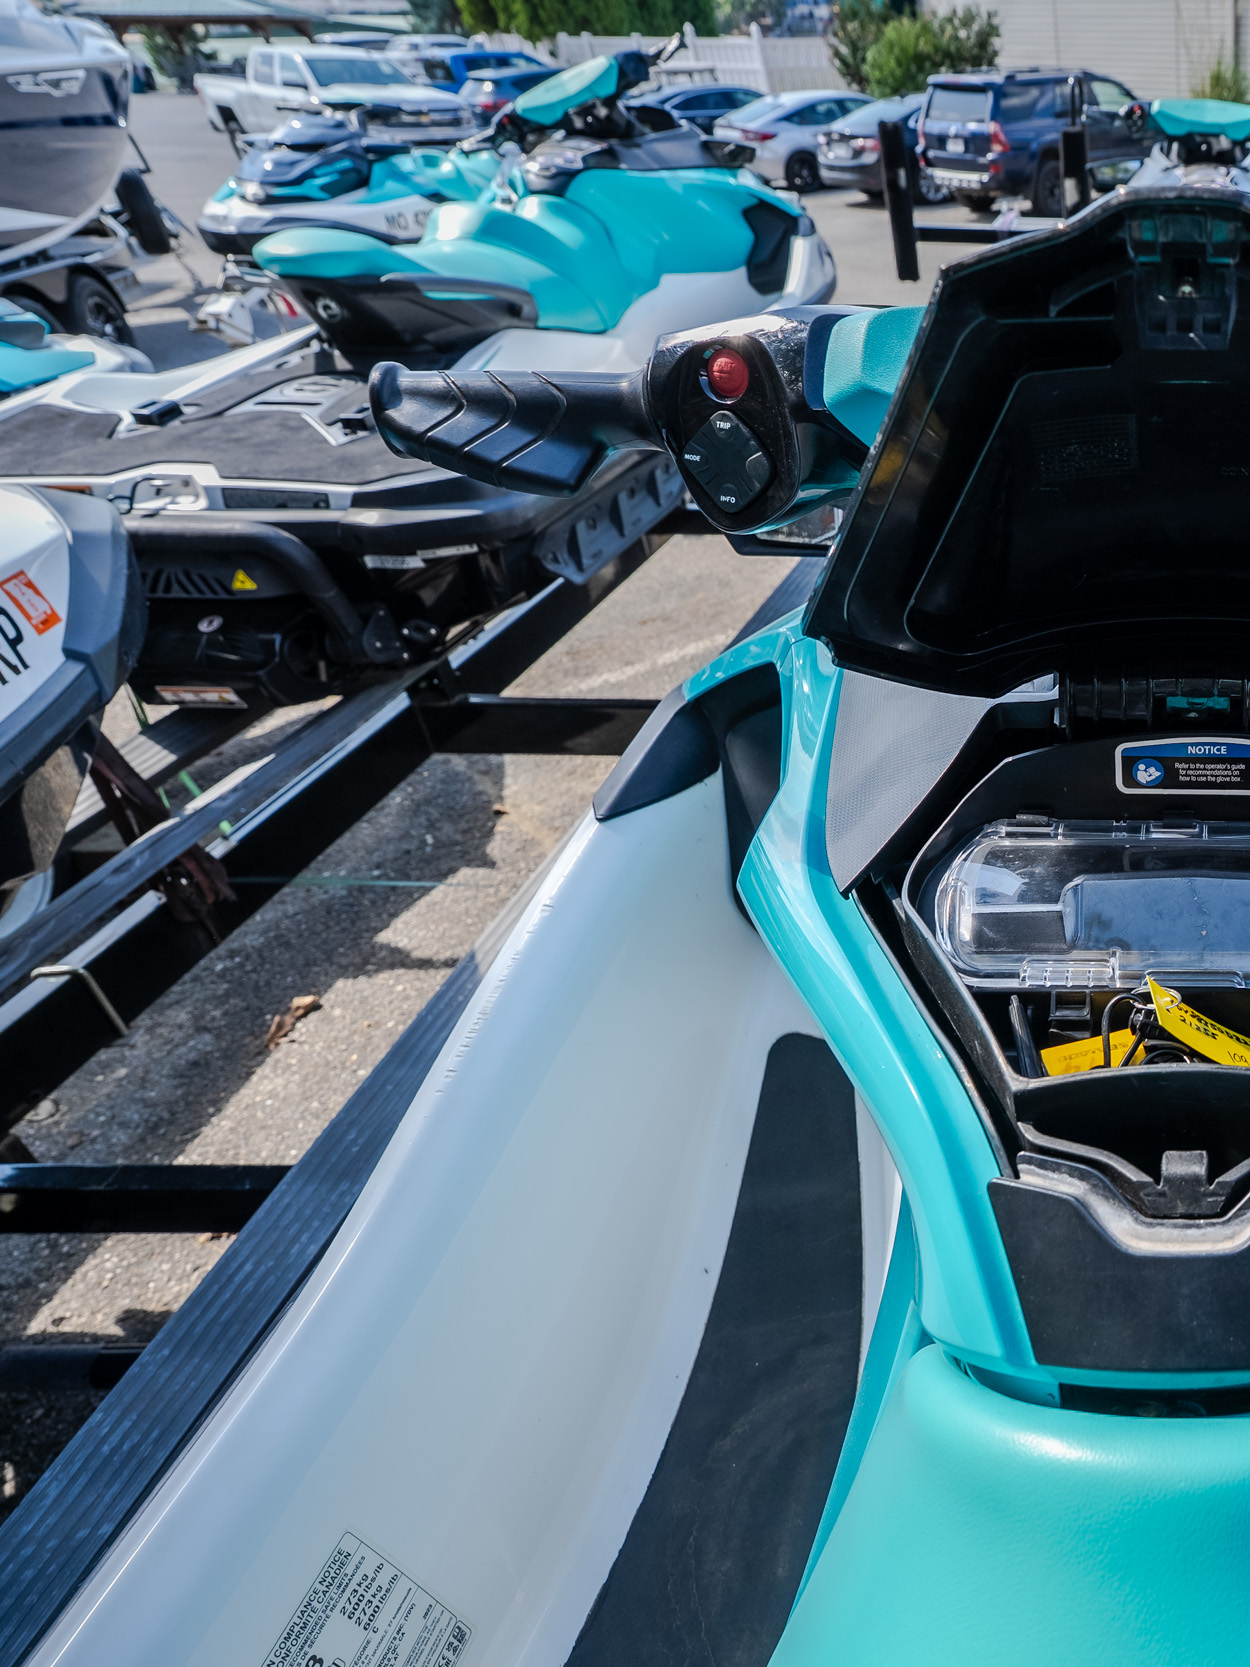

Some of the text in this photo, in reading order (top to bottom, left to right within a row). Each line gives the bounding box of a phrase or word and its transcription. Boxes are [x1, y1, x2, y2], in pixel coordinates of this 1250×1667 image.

[716, 421, 731, 430] TRIP
[684, 453, 701, 462] MODE
[720, 495, 736, 504] INFO
[1187, 746, 1227, 754] NOTICE
[316, 1551, 351, 1604] CANADIEN
[321, 1595, 334, 1614] SAFE
[333, 1572, 348, 1595] LIMITS
[340, 1573, 368, 1616] 273 kg
[347, 1563, 384, 1620] 600 lbs/lb
[274, 1547, 345, 1658] COMPLIANCE NOTICE
[300, 1556, 365, 1661] DE SÉCURITÉ RECOMMANDÉES
[355, 1585, 383, 1627] 273 kg
[363, 1574, 398, 1631] 600 lbs/lb
[396, 1623, 405, 1635] INC.
[404, 1603, 416, 1621] (YDV)
[423, 1604, 432, 1619] 2023
[398, 1632, 405, 1641] CA
[394, 1652, 399, 1661] AT
